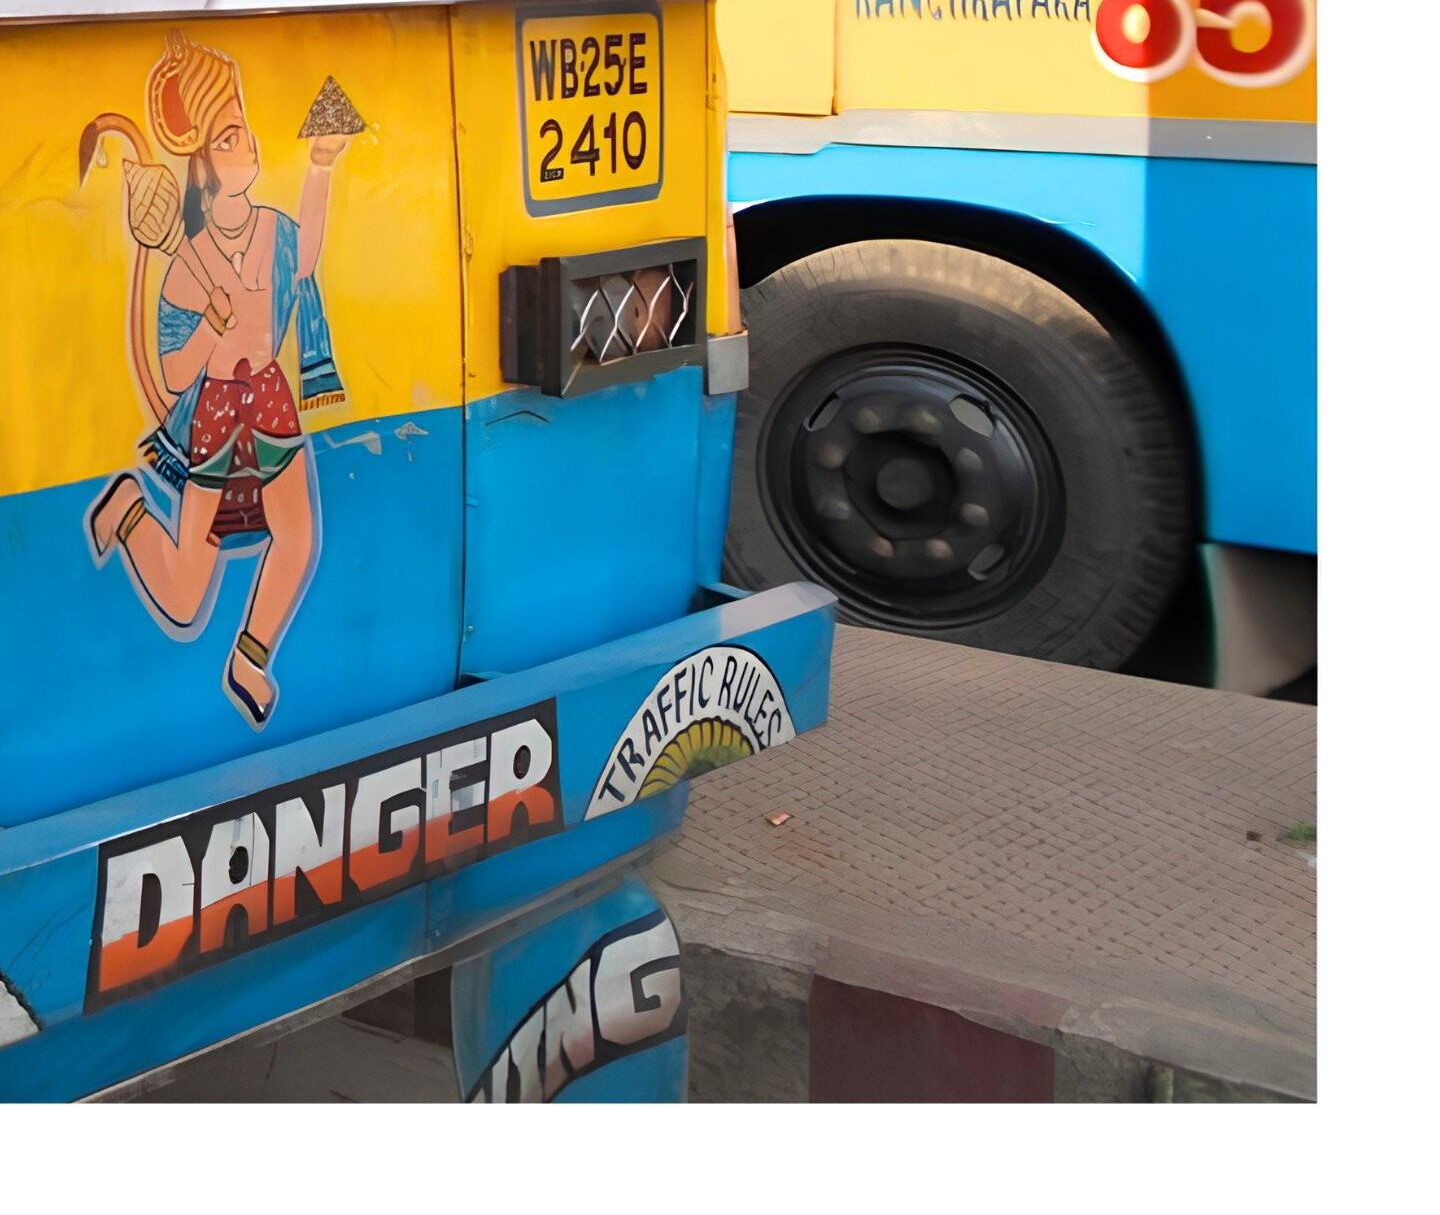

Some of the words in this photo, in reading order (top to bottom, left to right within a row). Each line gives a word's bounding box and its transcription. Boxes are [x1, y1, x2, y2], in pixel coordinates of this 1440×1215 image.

[540, 111, 647, 183] 2410
[598, 656, 715, 803] TRAFFIC
[717, 655, 782, 753] RULES
[99, 718, 555, 993] DANGER
